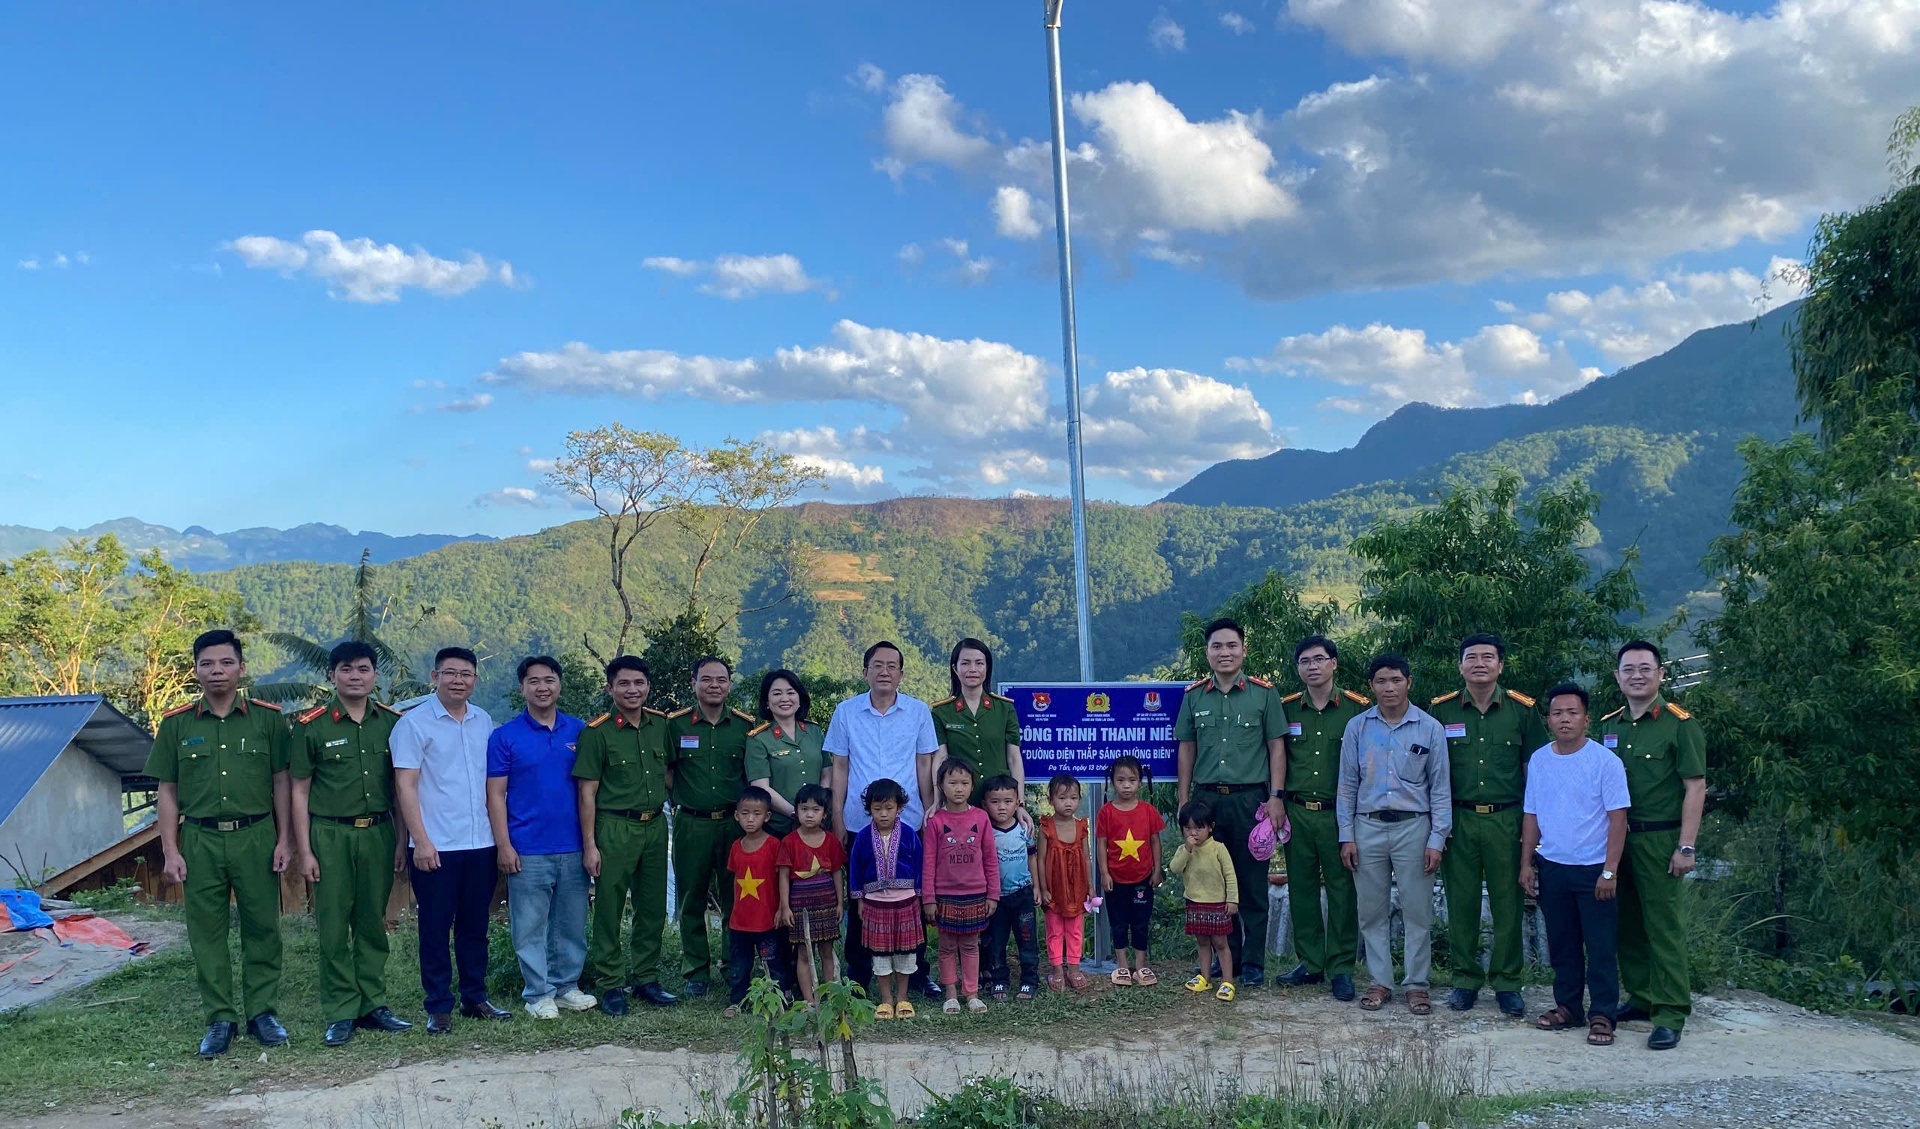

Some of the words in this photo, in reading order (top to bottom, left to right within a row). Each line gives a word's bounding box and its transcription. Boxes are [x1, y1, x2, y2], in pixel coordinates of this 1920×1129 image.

[1056, 725, 1097, 742] TRÌNH
[1100, 727, 1146, 741] THANH
[1056, 747, 1075, 762] ĐIỆN
[1076, 743, 1098, 760] THẮP
[1099, 746, 1121, 760] SÁNG
[949, 854, 975, 864] MEOW
